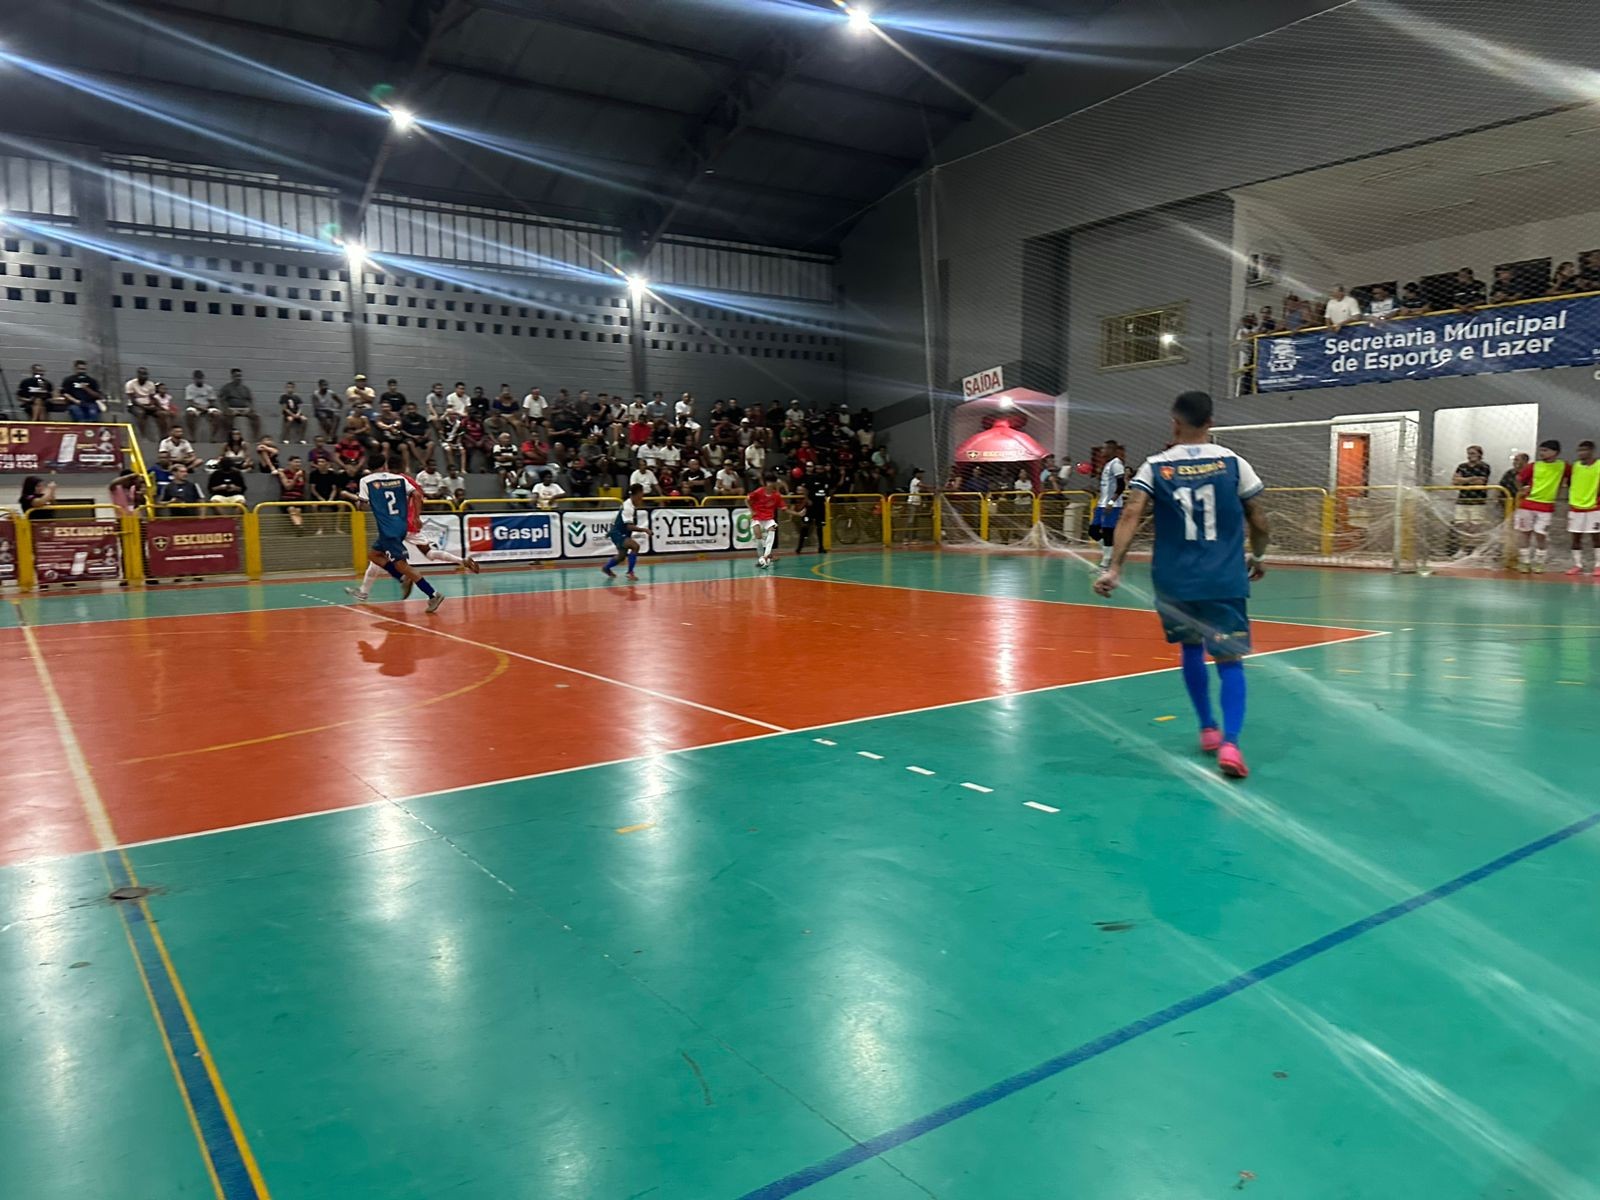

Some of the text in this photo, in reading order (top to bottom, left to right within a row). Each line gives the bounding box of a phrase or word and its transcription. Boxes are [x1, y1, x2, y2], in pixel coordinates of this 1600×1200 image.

[1323, 309, 1568, 355] Secretaria Municipal
[1331, 336, 1556, 373] de Esporte e Lazer
[964, 371, 1001, 396] SAÍDA
[384, 490, 399, 515] 2
[1172, 484, 1217, 541] 11
[469, 524, 549, 542] Di Gaspi
[662, 515, 718, 538] YESU
